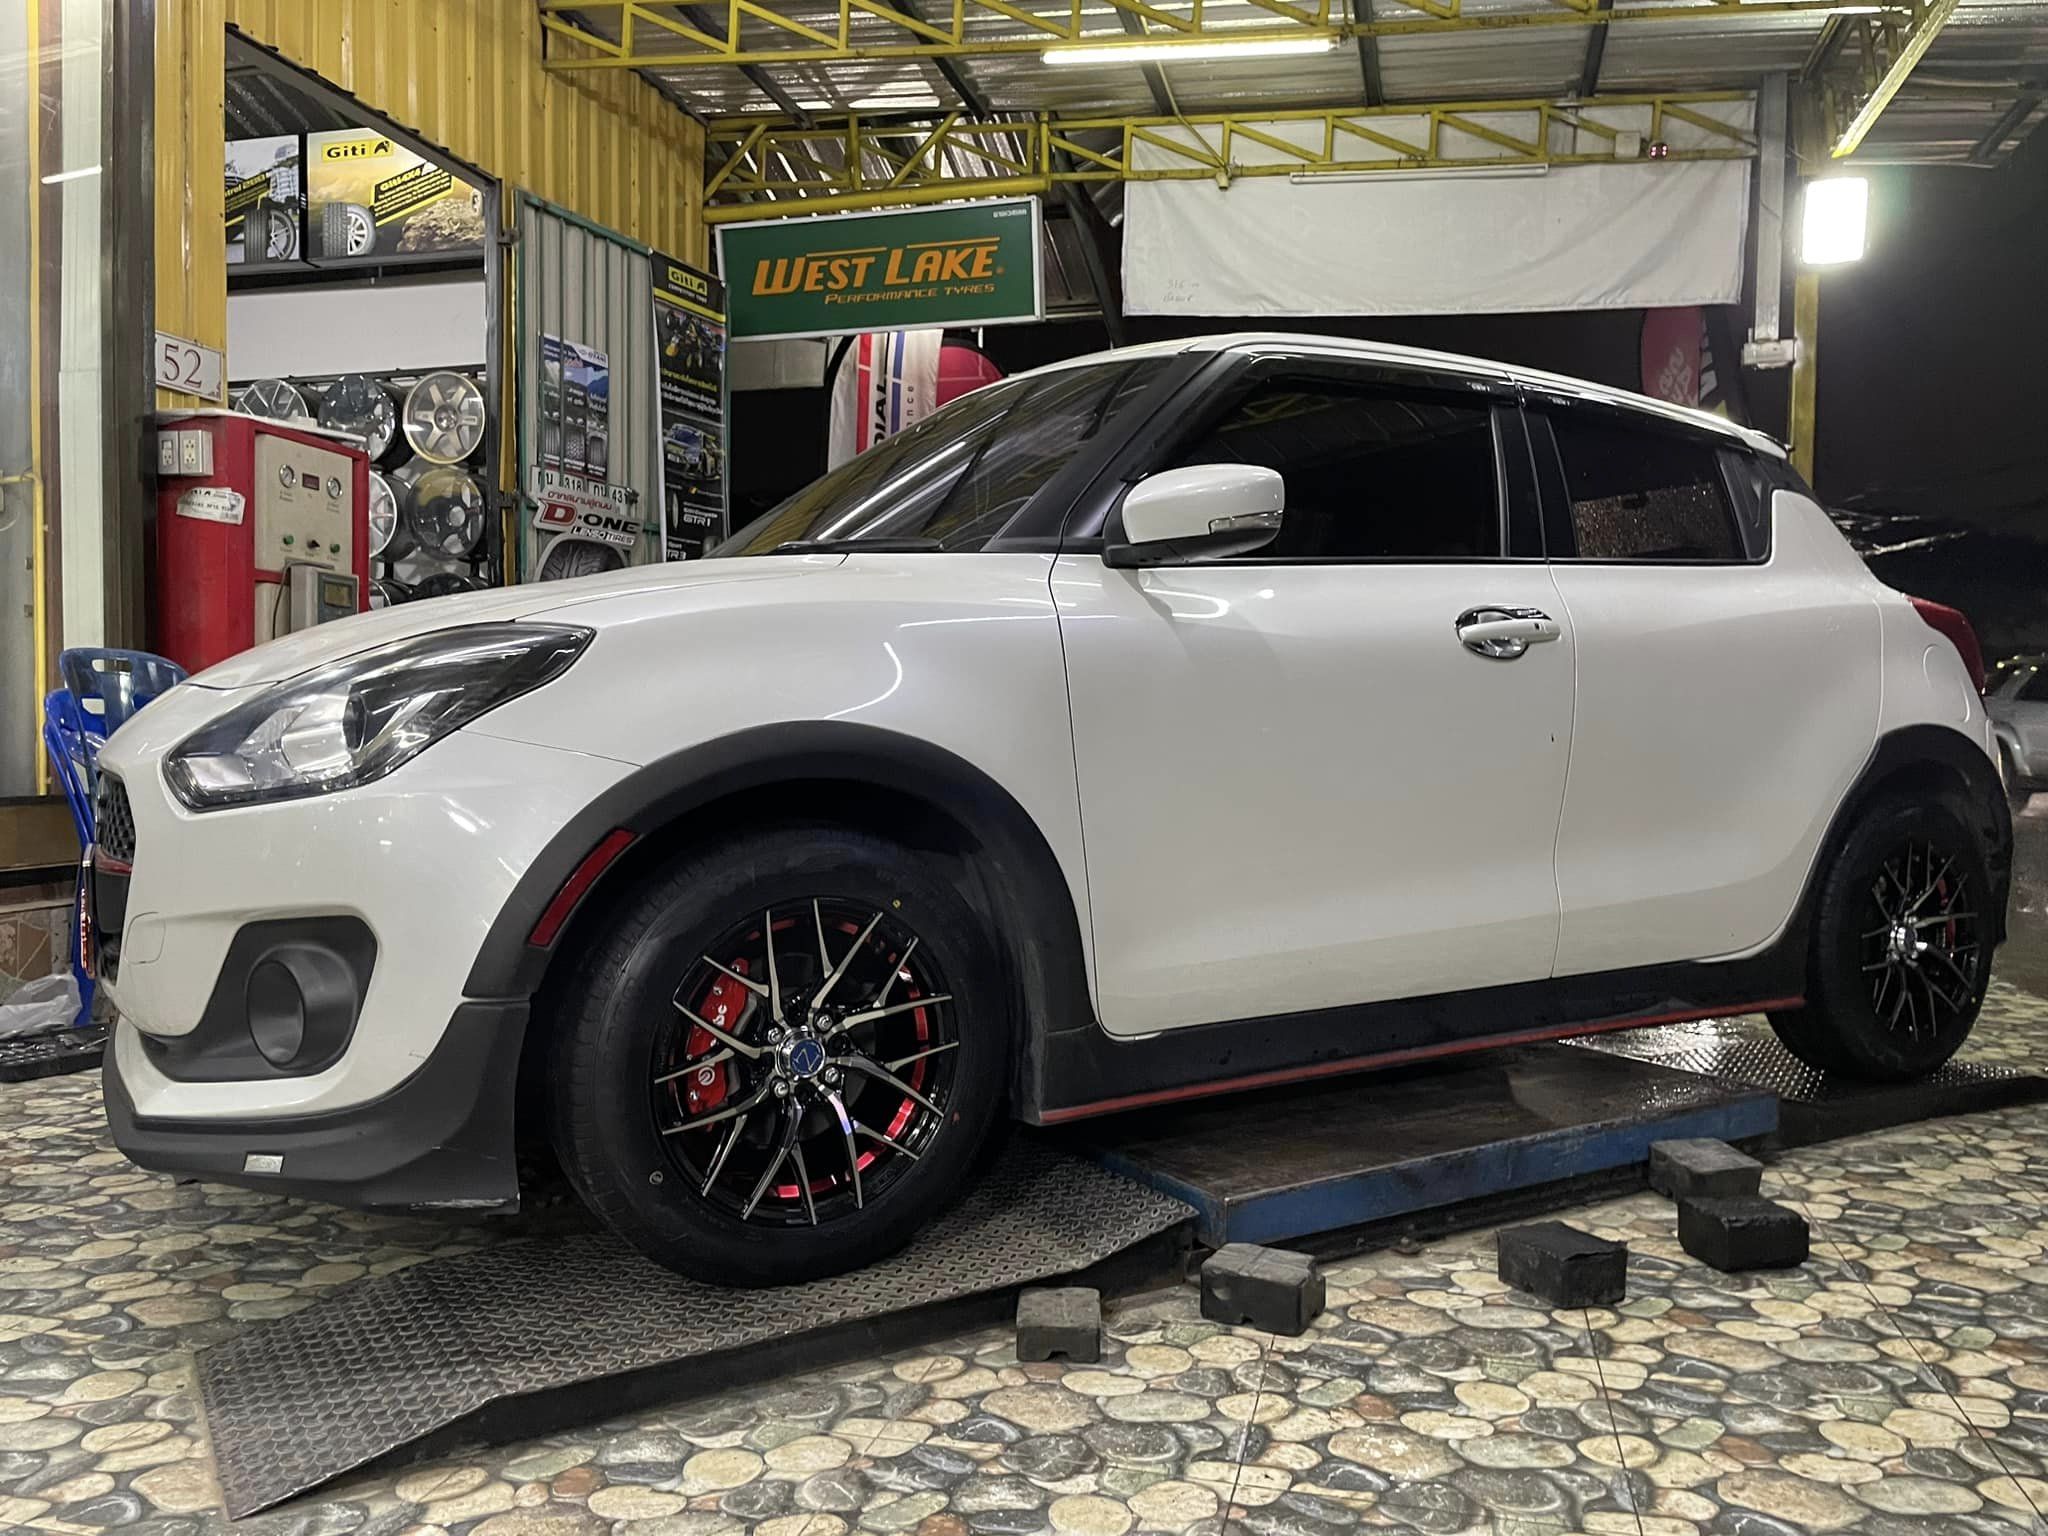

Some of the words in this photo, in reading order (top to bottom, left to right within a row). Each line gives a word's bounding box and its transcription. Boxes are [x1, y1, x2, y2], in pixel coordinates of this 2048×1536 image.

[326, 143, 366, 159] Giti
[752, 256, 876, 296] WEST
[884, 246, 999, 286] LAKE
[824, 287, 939, 305] PERFORMANCE
[944, 282, 996, 297] TYRES
[162, 343, 202, 388] 52
